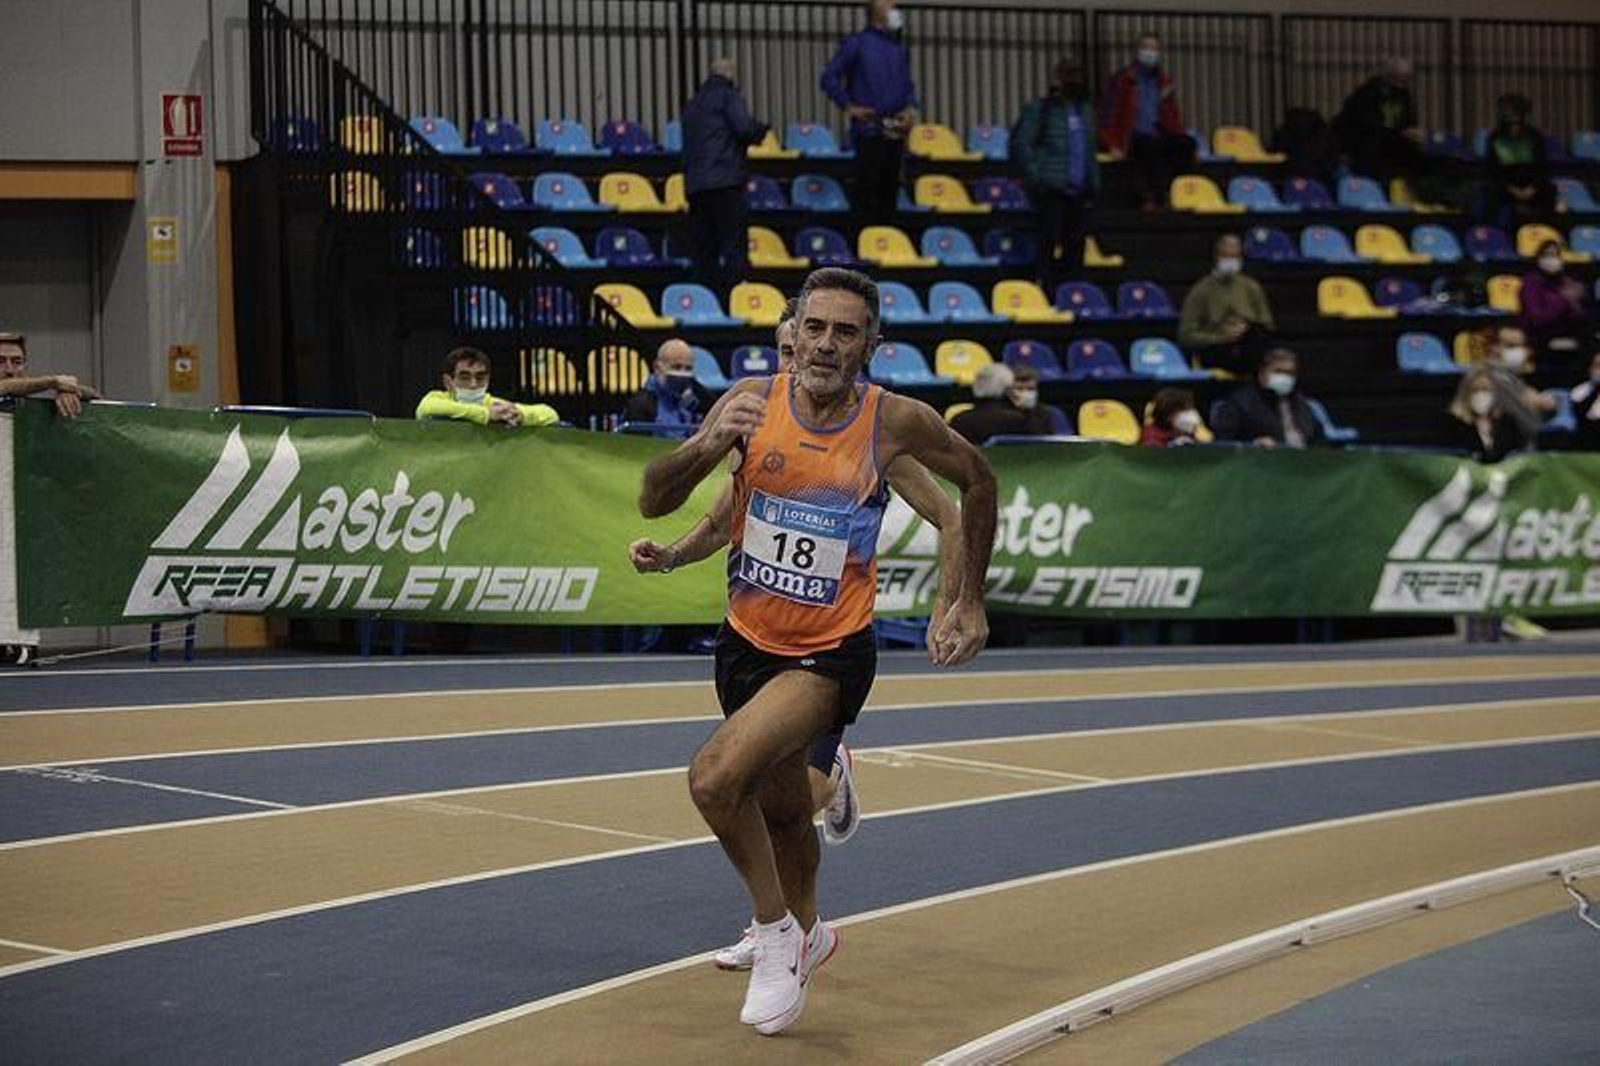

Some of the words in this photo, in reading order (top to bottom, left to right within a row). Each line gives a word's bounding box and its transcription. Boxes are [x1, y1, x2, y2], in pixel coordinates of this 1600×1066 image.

[150, 424, 474, 553] Master
[772, 532, 816, 570] 18
[152, 565, 276, 607] RFEA
[276, 564, 599, 611] ATLETISMO
